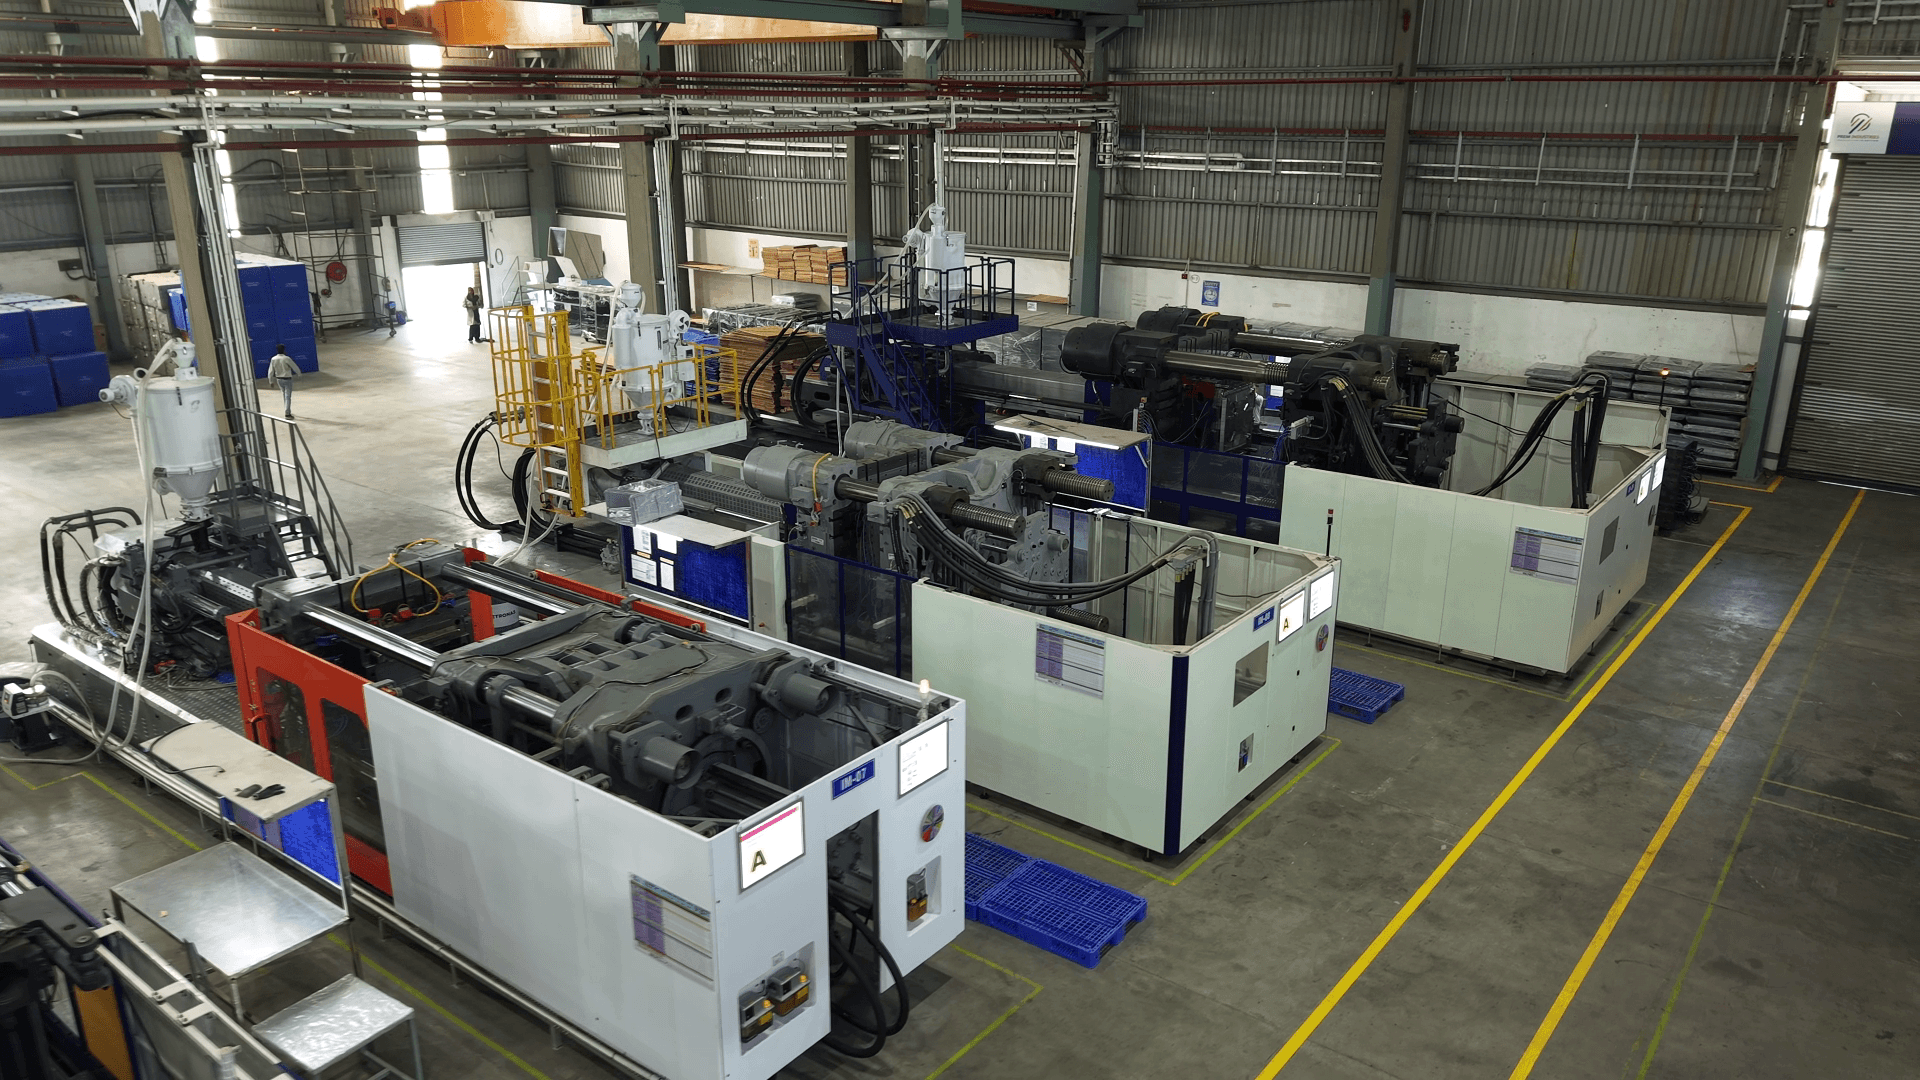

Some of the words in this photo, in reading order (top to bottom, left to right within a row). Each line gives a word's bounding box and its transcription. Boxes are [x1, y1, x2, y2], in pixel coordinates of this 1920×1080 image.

[492, 609, 516, 619] TRONAS
[841, 766, 867, 791] IM-07
[749, 849, 767, 873] A
